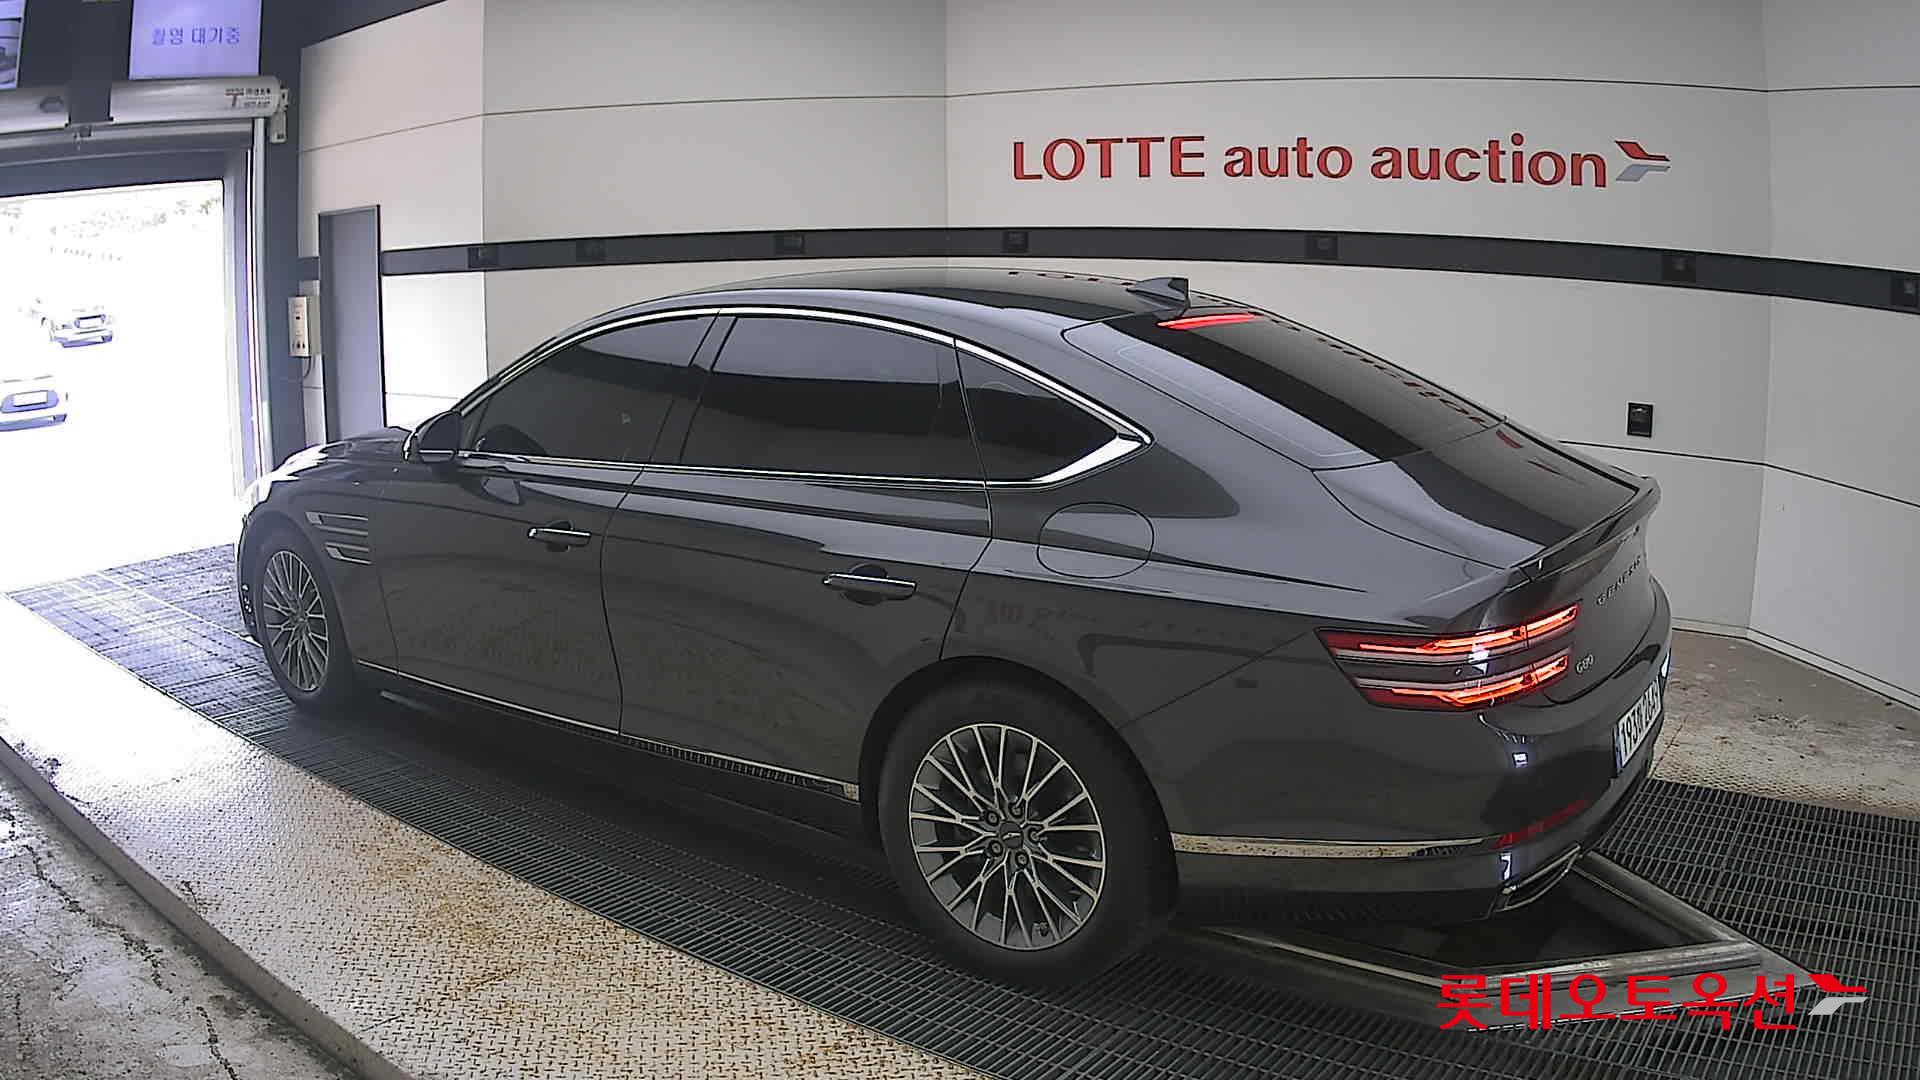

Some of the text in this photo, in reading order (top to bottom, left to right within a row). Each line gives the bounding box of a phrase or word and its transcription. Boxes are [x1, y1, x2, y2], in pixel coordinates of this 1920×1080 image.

[191, 25, 241, 45] 대기중
[1012, 133, 1607, 188] LOTTE auto auction
